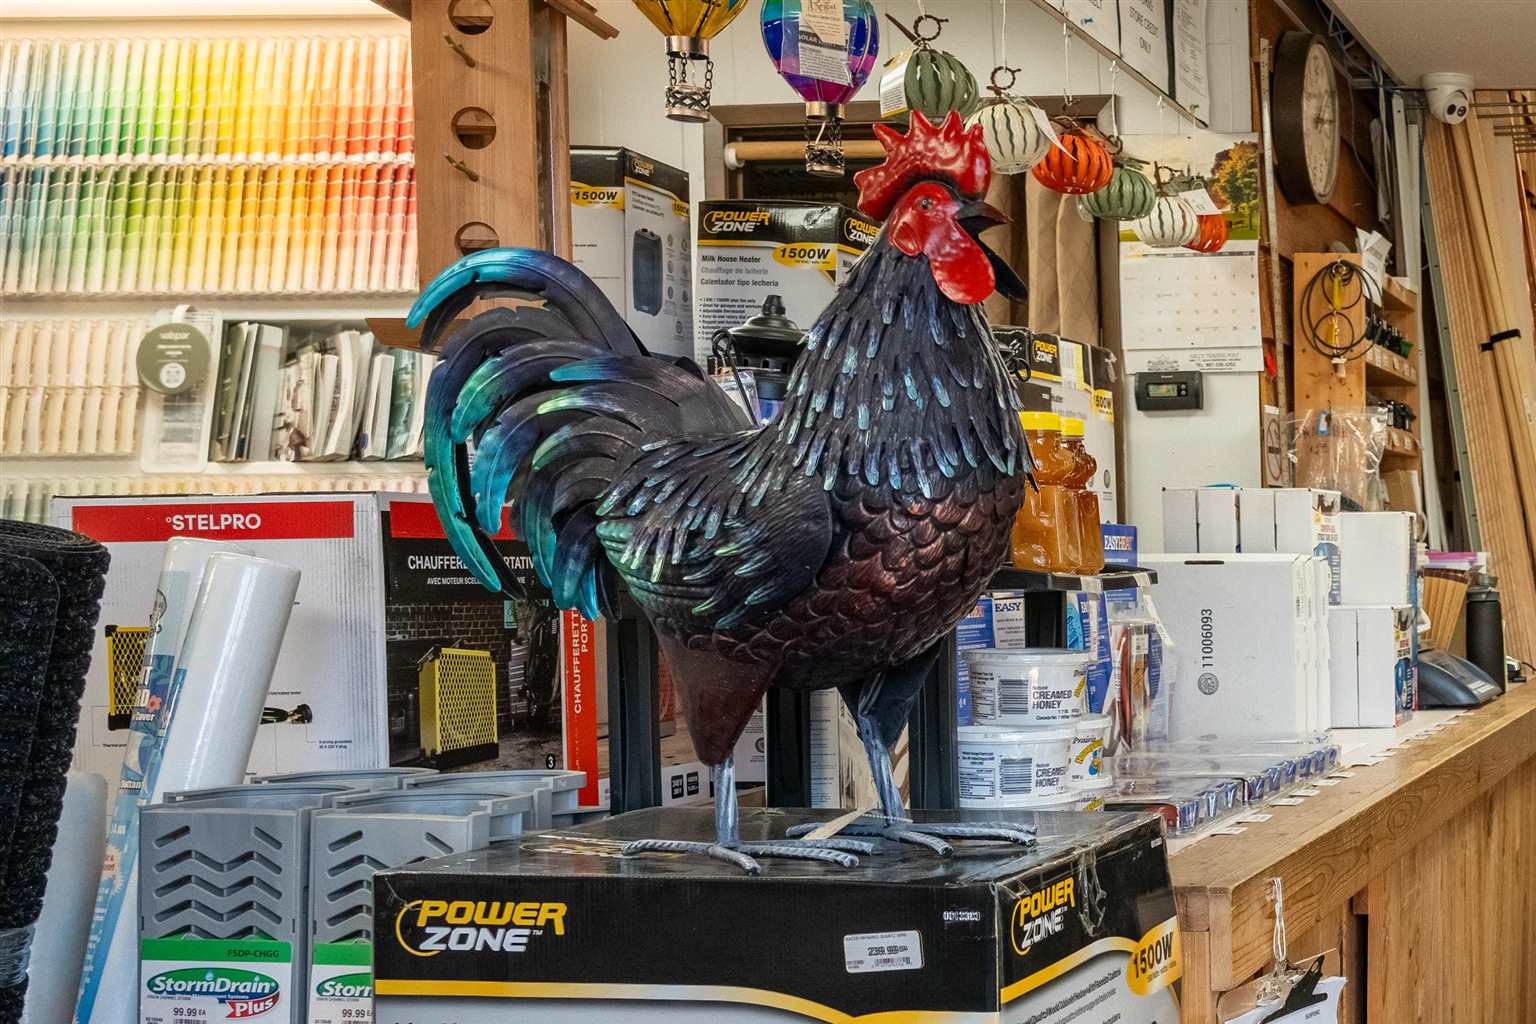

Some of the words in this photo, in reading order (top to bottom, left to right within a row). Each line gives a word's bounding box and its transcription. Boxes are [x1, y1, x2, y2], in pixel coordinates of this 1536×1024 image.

[574, 191, 618, 201] 1500W
[711, 211, 769, 226] POWER
[712, 222, 756, 232] ZONE
[850, 229, 875, 245] ZONE
[702, 255, 715, 263] Milk
[717, 255, 738, 264] House
[780, 248, 831, 260] 1500W
[427, 577, 441, 585] AVEC
[442, 577, 464, 585] MOTEUR
[995, 602, 1022, 613] EASY
[1201, 608, 1214, 668] 11006093
[1032, 690, 1072, 700] CREAMED
[1032, 700, 1061, 710] HONEY
[1035, 777, 1060, 788] HONEY
[1018, 876, 1077, 926] POWER
[417, 899, 567, 936] POWER
[1020, 908, 1065, 950] ZONE
[418, 928, 532, 953] ZONE
[1133, 931, 1175, 980] 1500W
[152, 975, 272, 994] StormDrain
[173, 1007, 198, 1017] 99.99
[235, 998, 275, 1017] Plus
